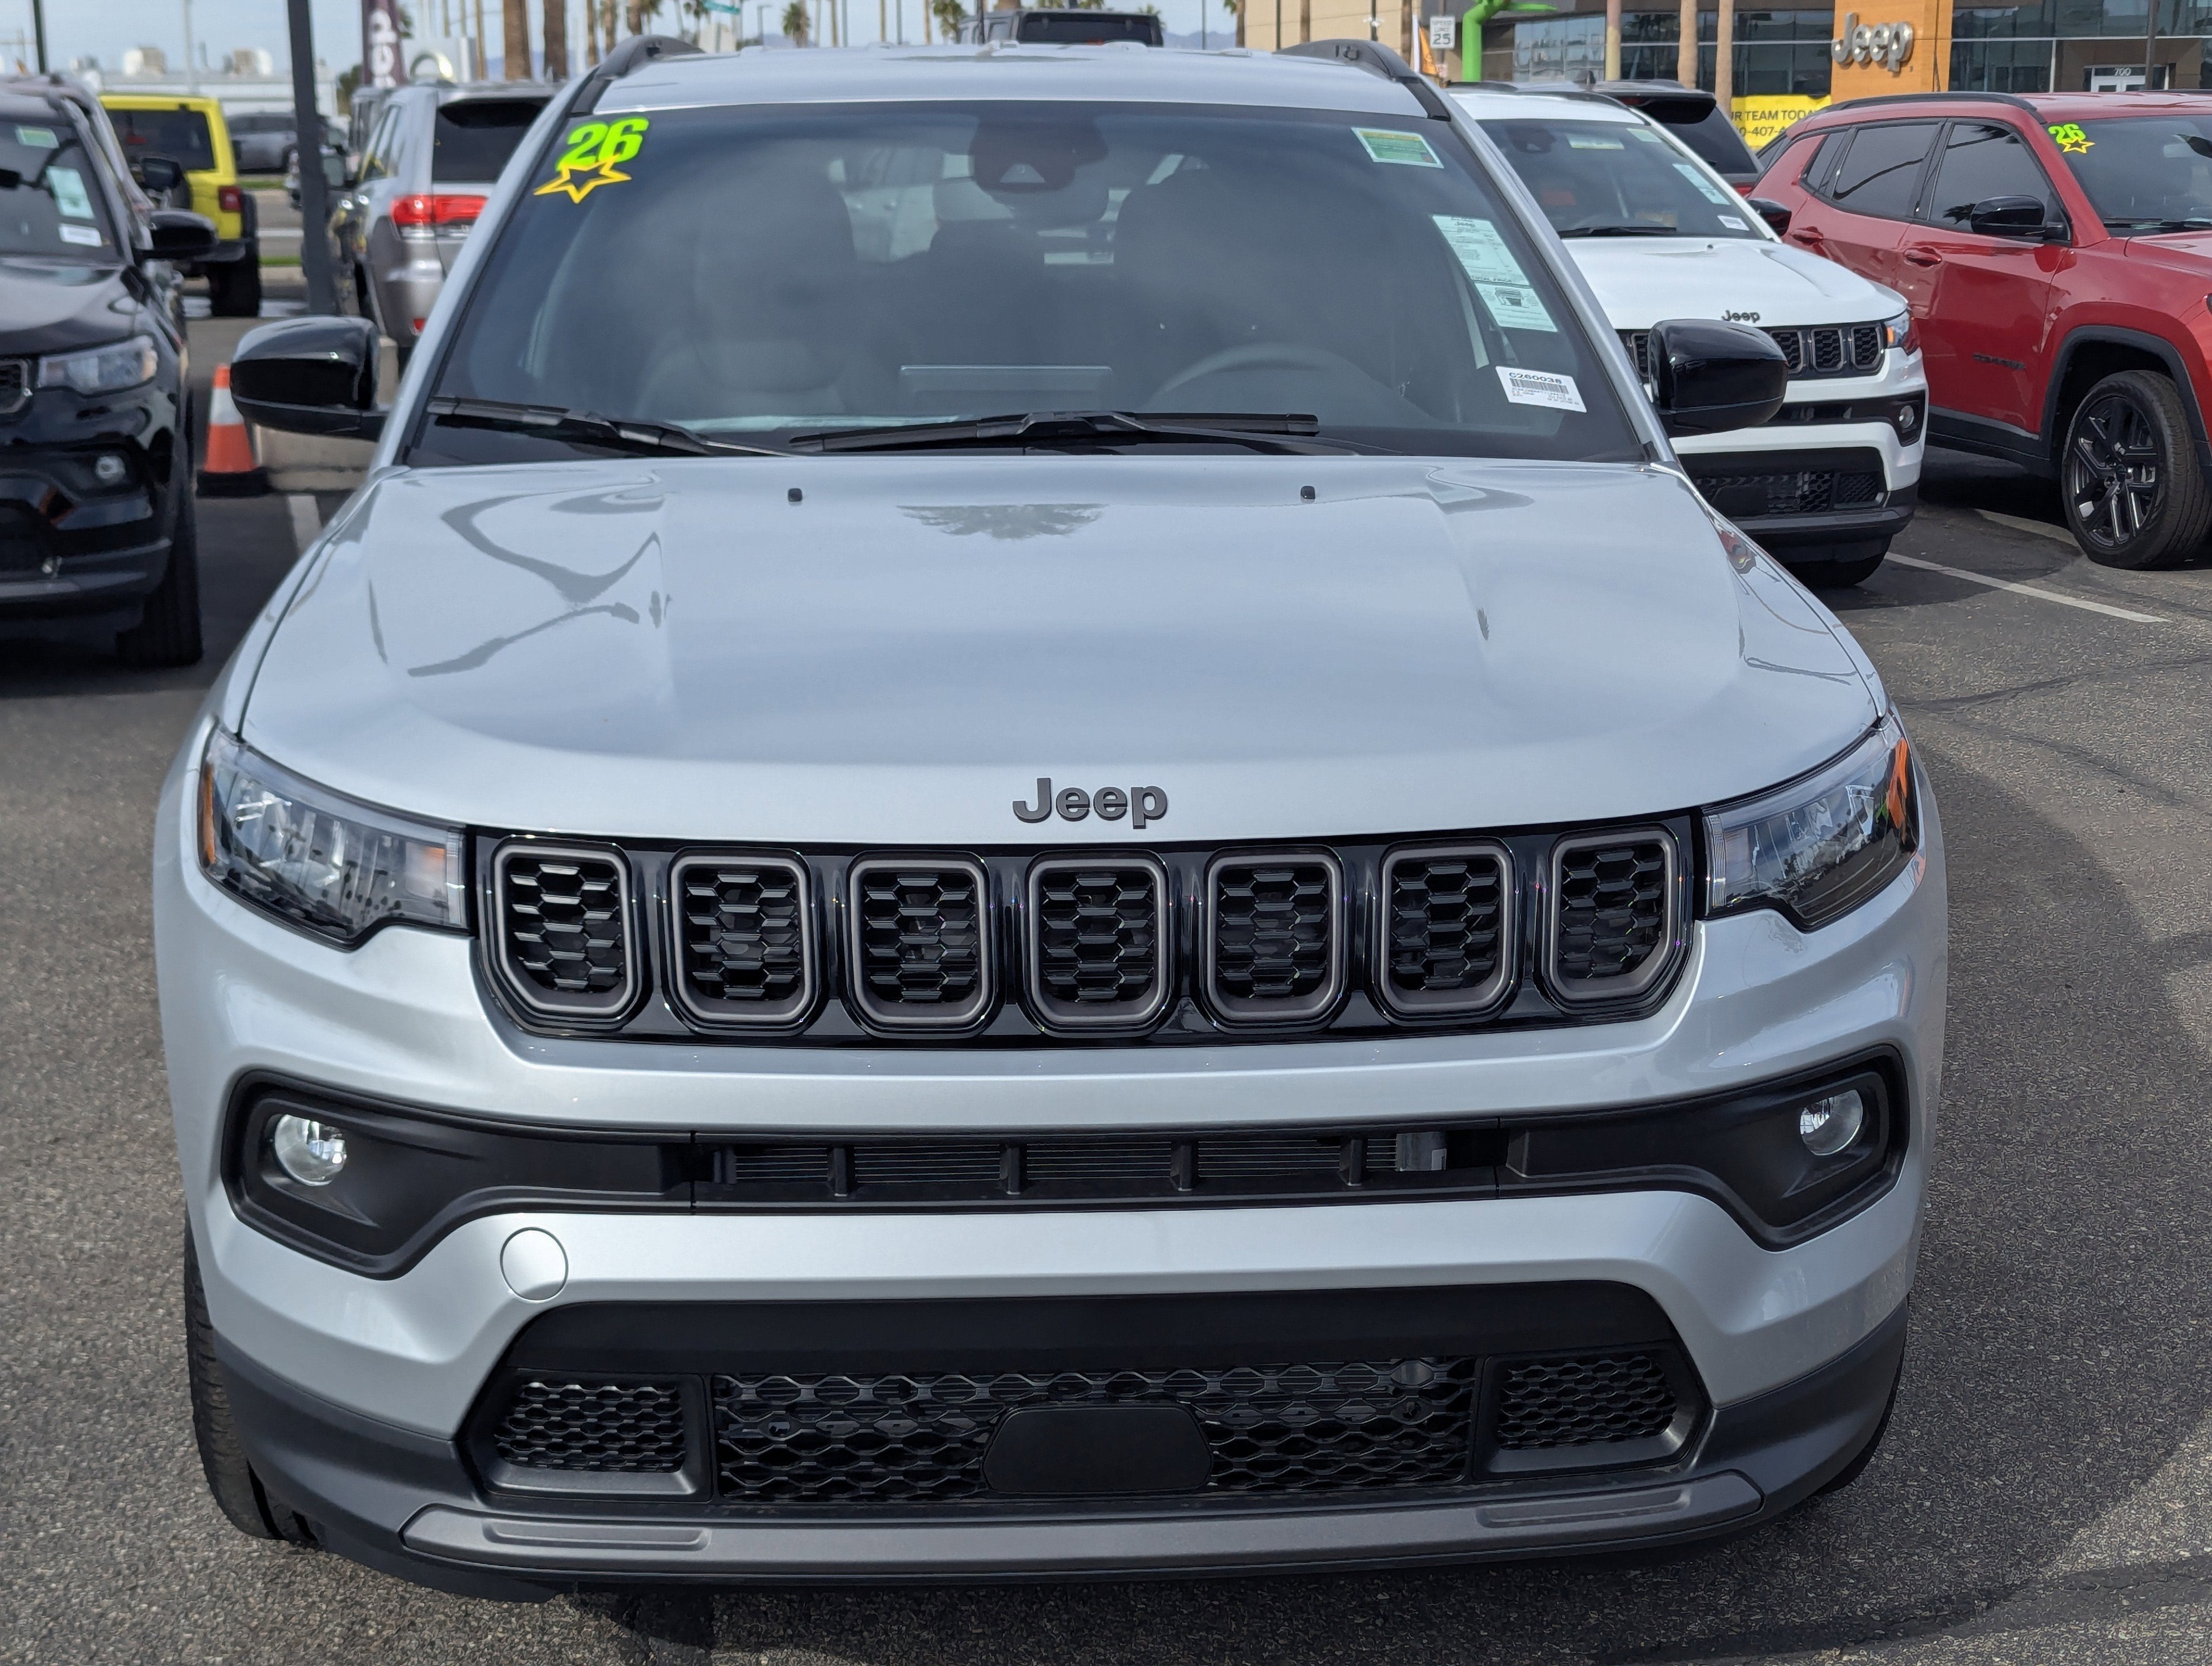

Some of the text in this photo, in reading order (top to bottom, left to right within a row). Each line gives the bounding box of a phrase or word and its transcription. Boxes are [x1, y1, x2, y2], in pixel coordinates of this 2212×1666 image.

[1433, 33, 1451, 44] 25
[1831, 12, 1913, 72] Jeep
[2114, 67, 2131, 76] 700
[1745, 110, 1778, 120] TEAM
[2048, 124, 2086, 144] 26
[555, 117, 650, 172] 26
[1721, 310, 1760, 324] Jeep
[1012, 777, 1168, 830] Jeep
